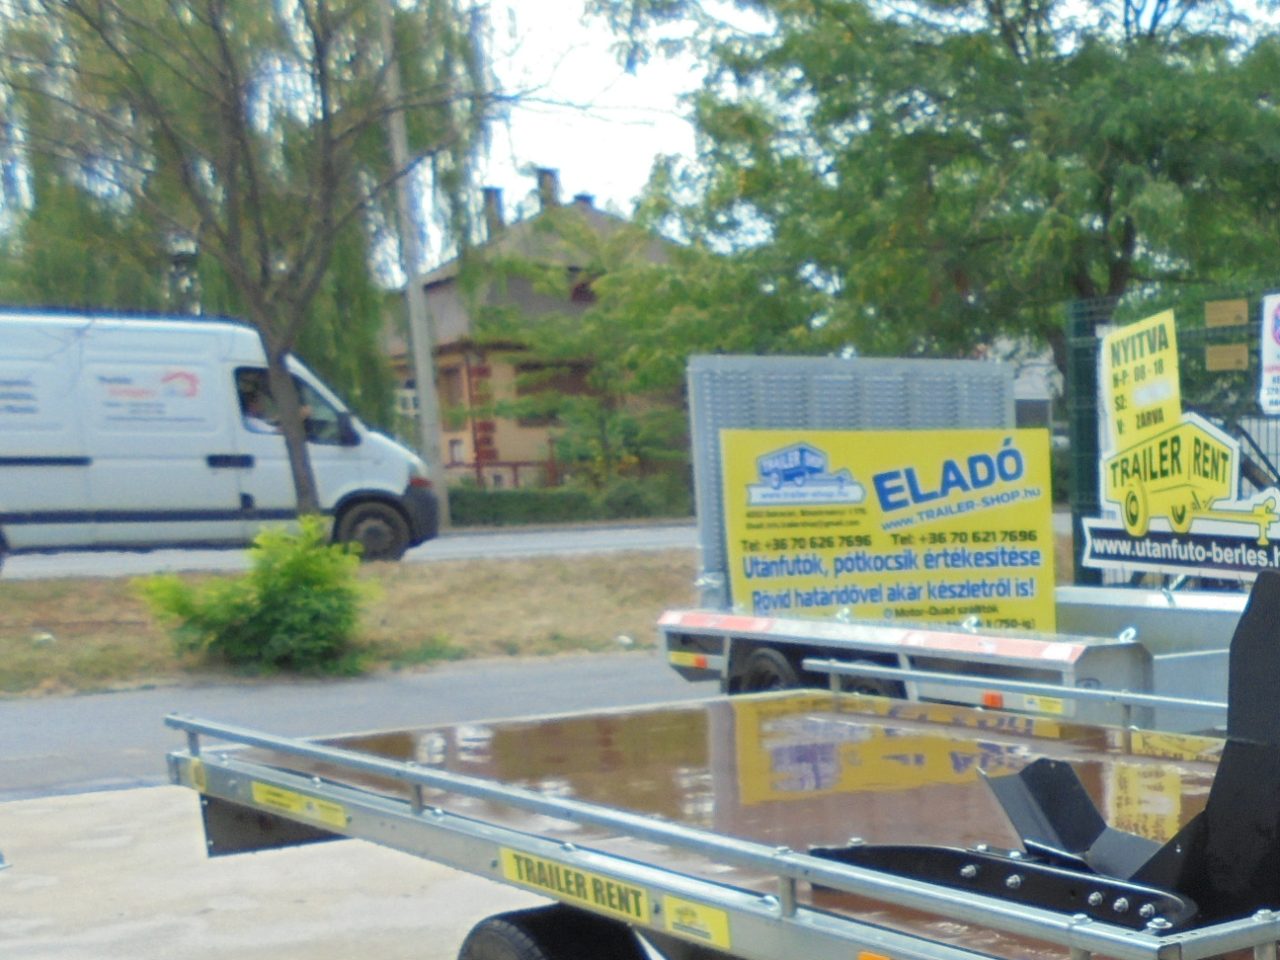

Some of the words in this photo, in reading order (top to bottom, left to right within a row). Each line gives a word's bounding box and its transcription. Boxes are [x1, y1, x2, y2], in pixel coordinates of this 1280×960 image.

[1110, 323, 1169, 368] NYITVA
[872, 437, 1024, 513] ELADÓ
[1110, 435, 1183, 488] TRAILER
[1193, 436, 1230, 485] RENT
[838, 535, 872, 547] 7696
[951, 531, 968, 544] 70
[972, 531, 997, 543] 621
[1001, 530, 1038, 542] 7696
[1015, 577, 1035, 598] is!
[513, 853, 588, 901] TRAILER
[592, 876, 643, 918] RENT
